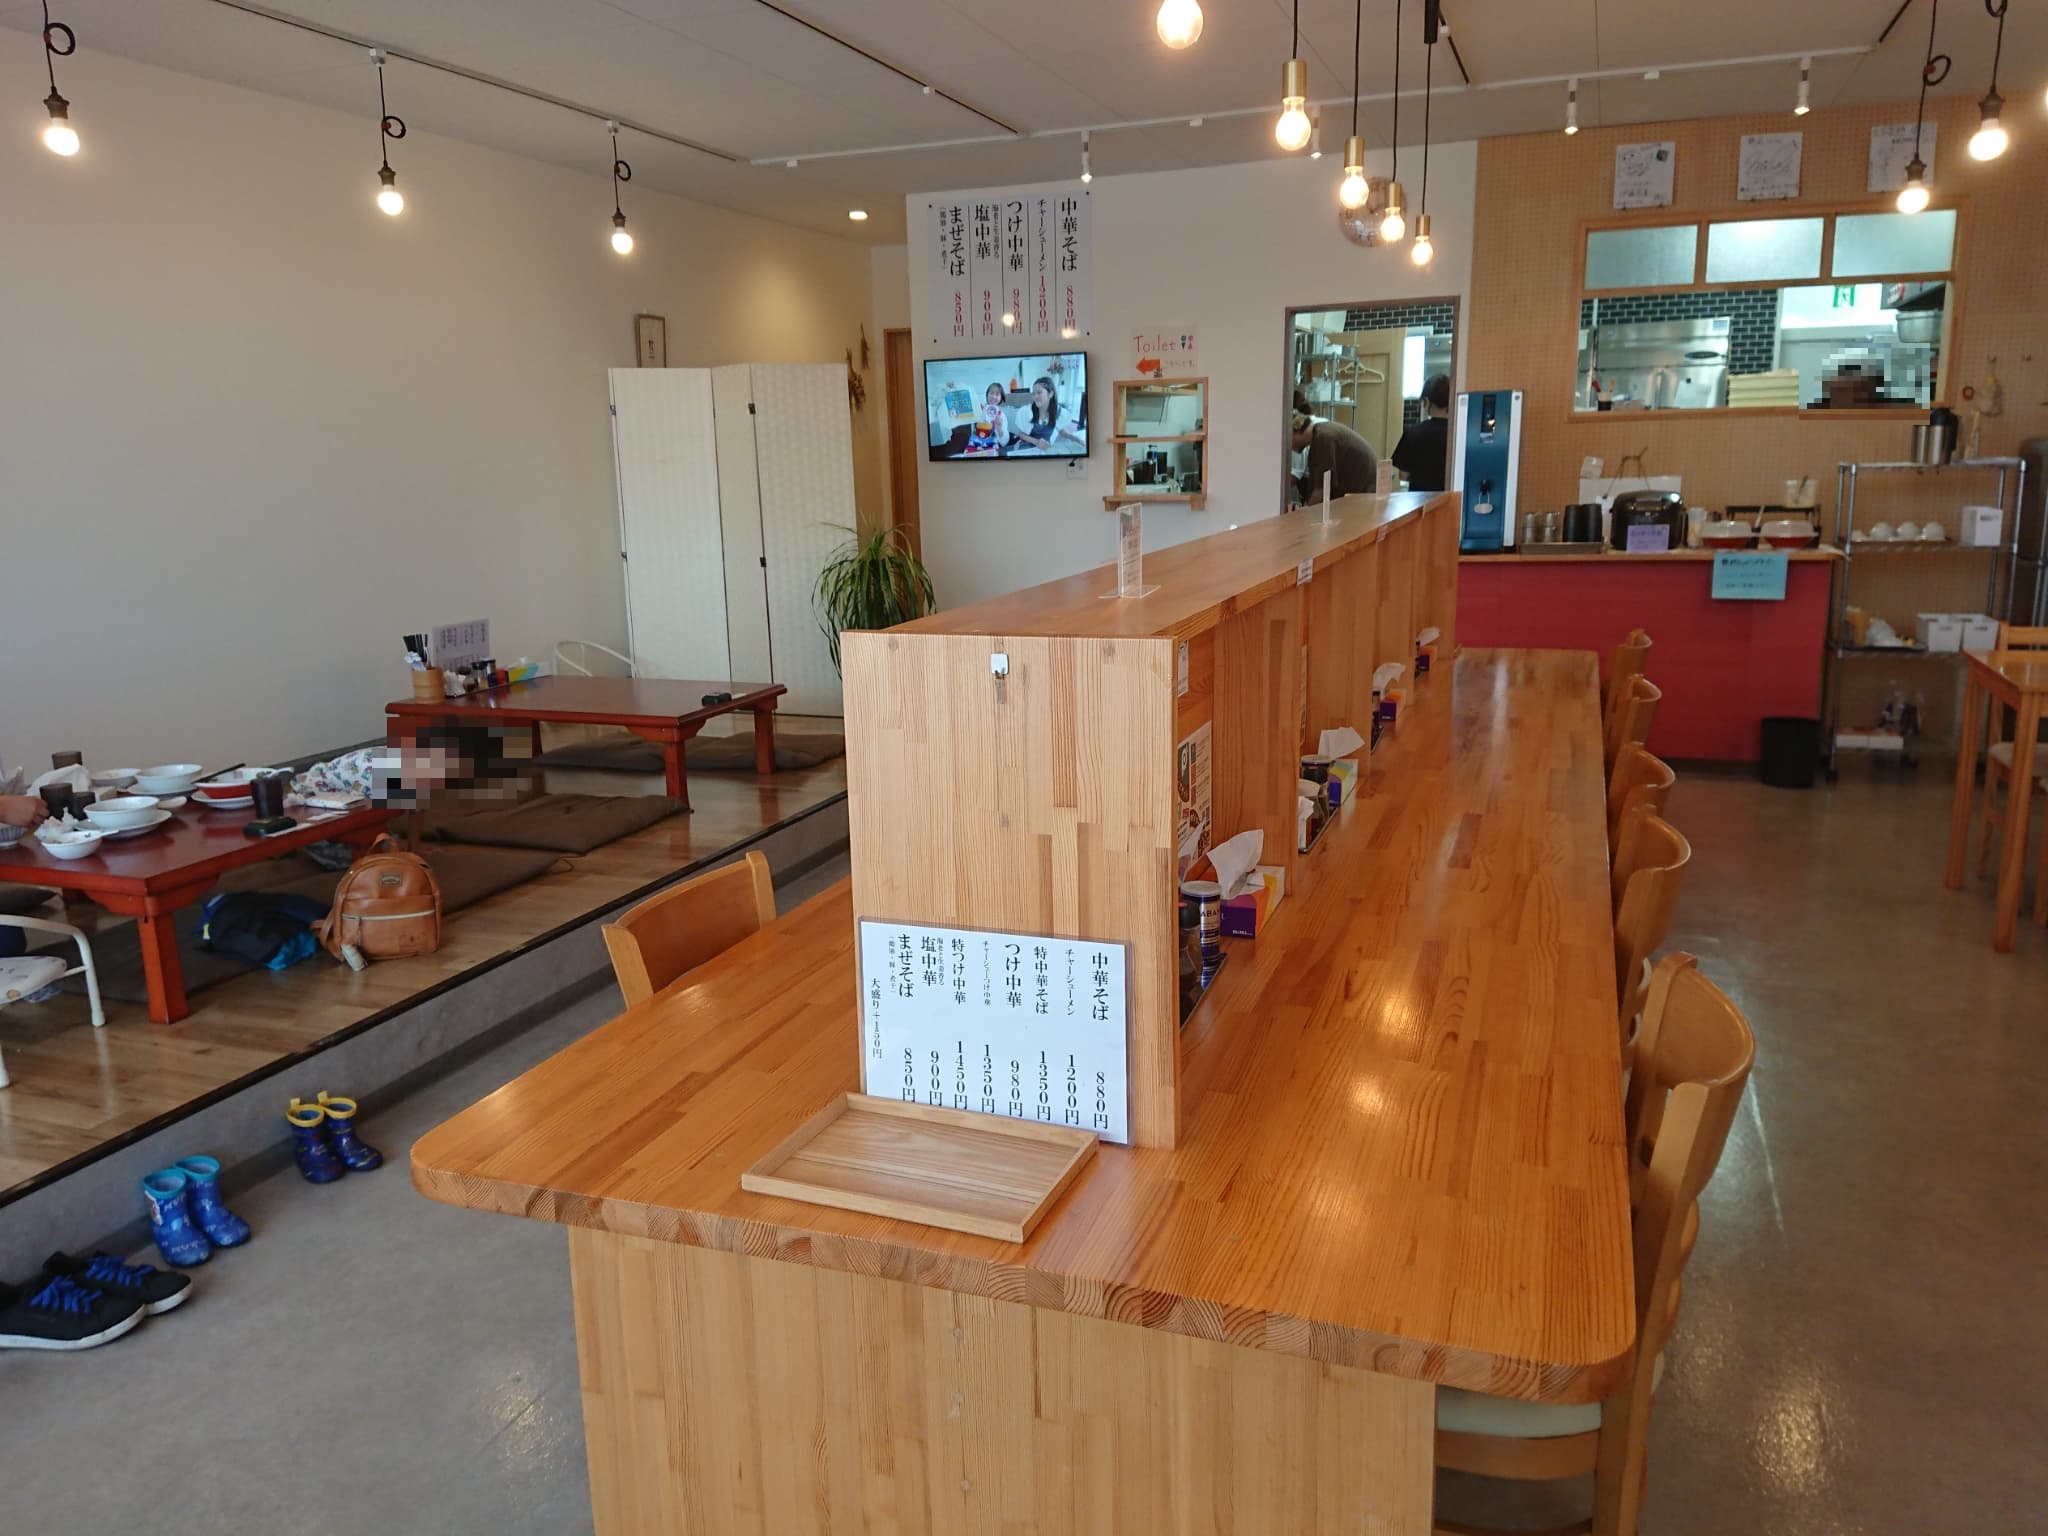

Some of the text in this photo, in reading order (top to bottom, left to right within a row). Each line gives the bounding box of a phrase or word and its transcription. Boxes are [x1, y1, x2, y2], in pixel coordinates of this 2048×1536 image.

[949, 206, 965, 336] まぜそば 850円
[974, 203, 993, 336] 塩中華 900円
[1007, 201, 1023, 335] つけ中華 980円
[1037, 199, 1049, 272] チャーシューメン
[1061, 197, 1078, 272] 中華そば
[1133, 334, 1176, 353] Toilet
[898, 933, 916, 1103] まぜそば 850円
[920, 935, 943, 1107] 塩中華 900円
[951, 938, 968, 1110] 特つけ中華 1450円
[981, 1044, 995, 1114] 1350円
[1005, 943, 1023, 1117] つけ中華 980円
[1034, 946, 1051, 1121] 特中華そば 1350円
[1065, 949, 1079, 1126] チャーシューメン 1200円
[1092, 952, 1109, 1130] 中華そば 880円
